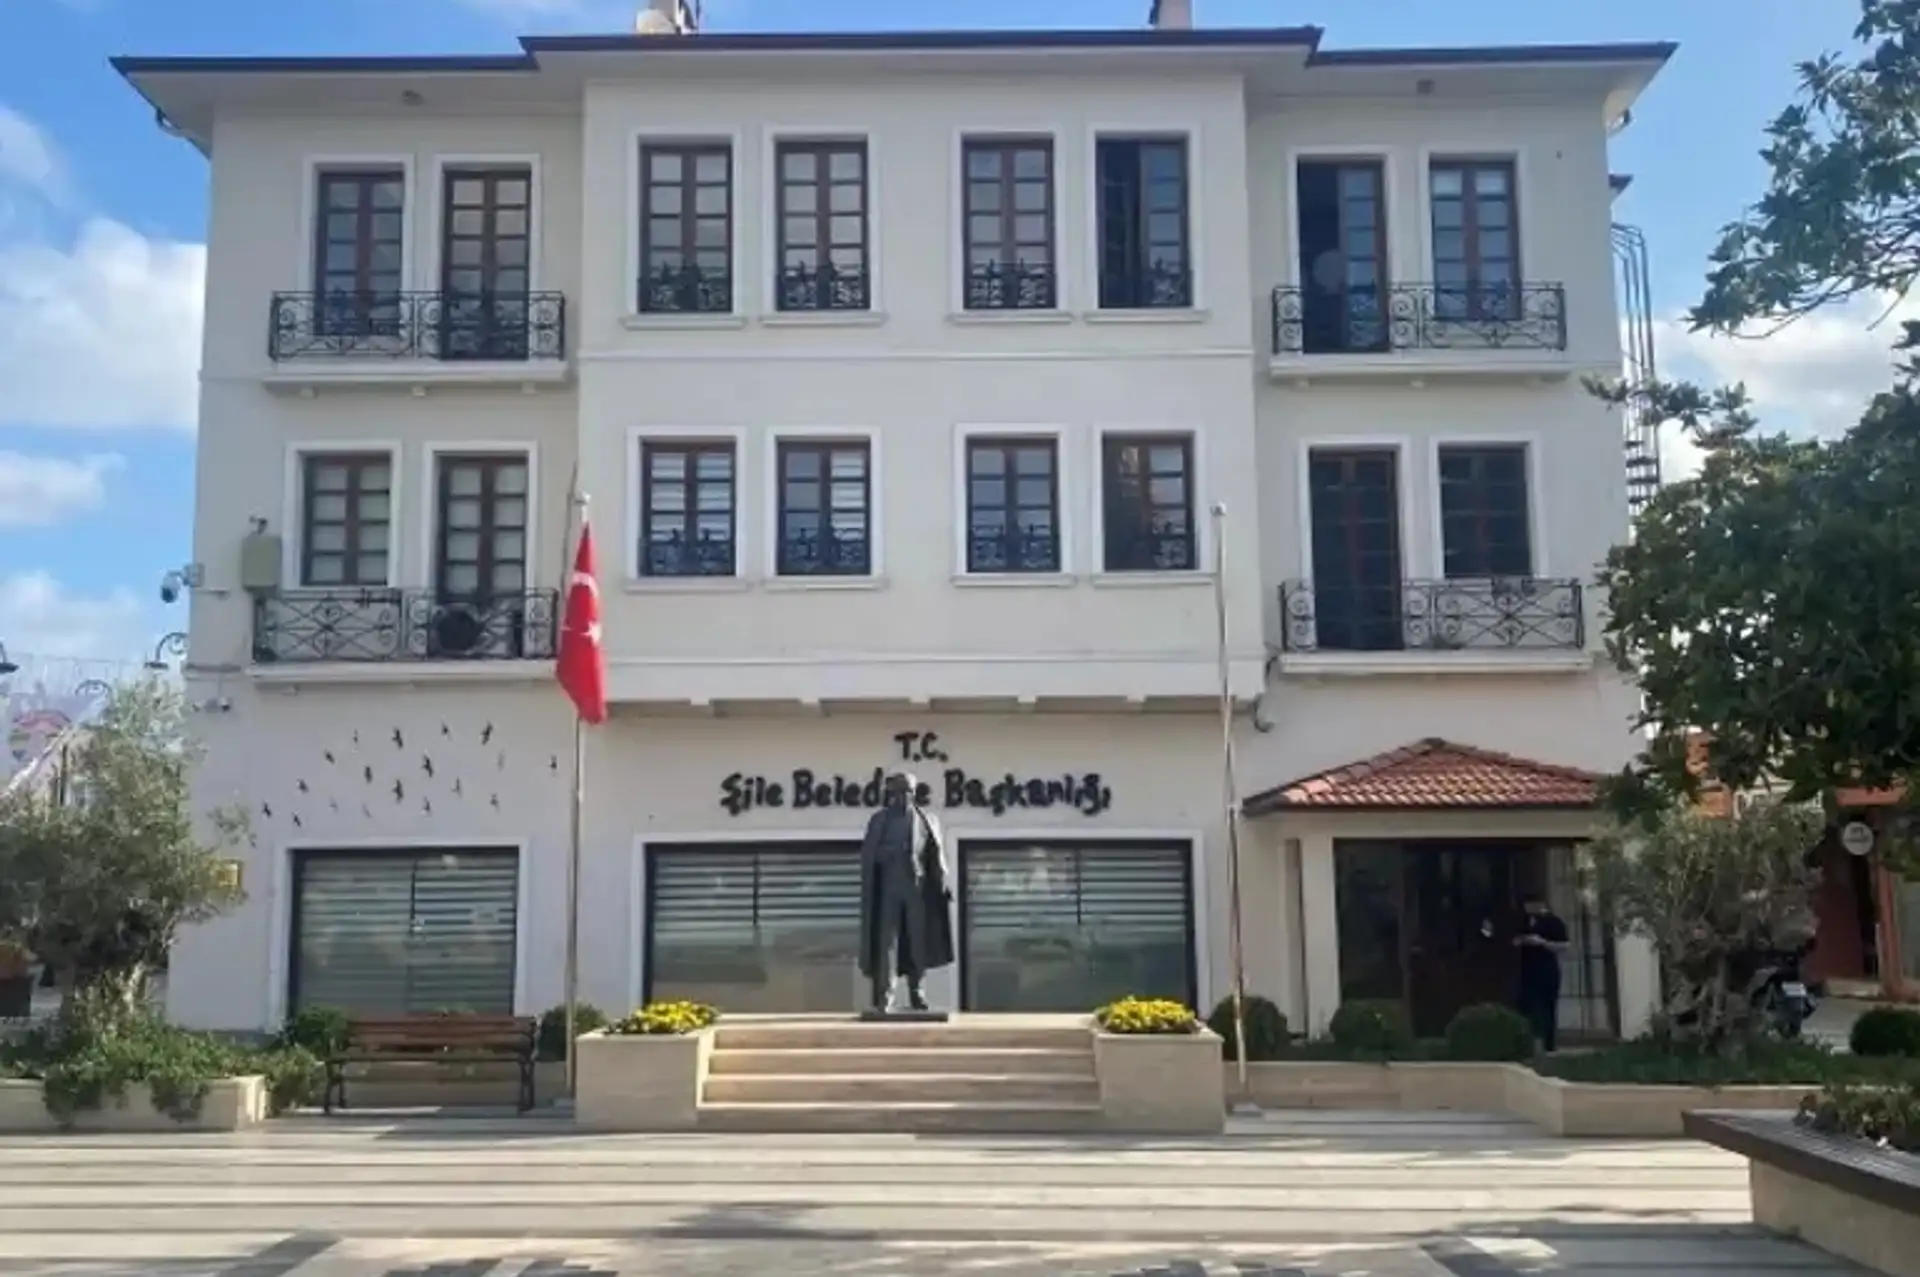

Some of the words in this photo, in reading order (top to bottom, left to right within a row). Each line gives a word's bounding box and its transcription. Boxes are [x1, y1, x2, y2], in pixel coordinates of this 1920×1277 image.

[894, 731, 949, 763] T.C.
[720, 771, 784, 817] Şile
[944, 768, 1111, 816] Başkanlığı
